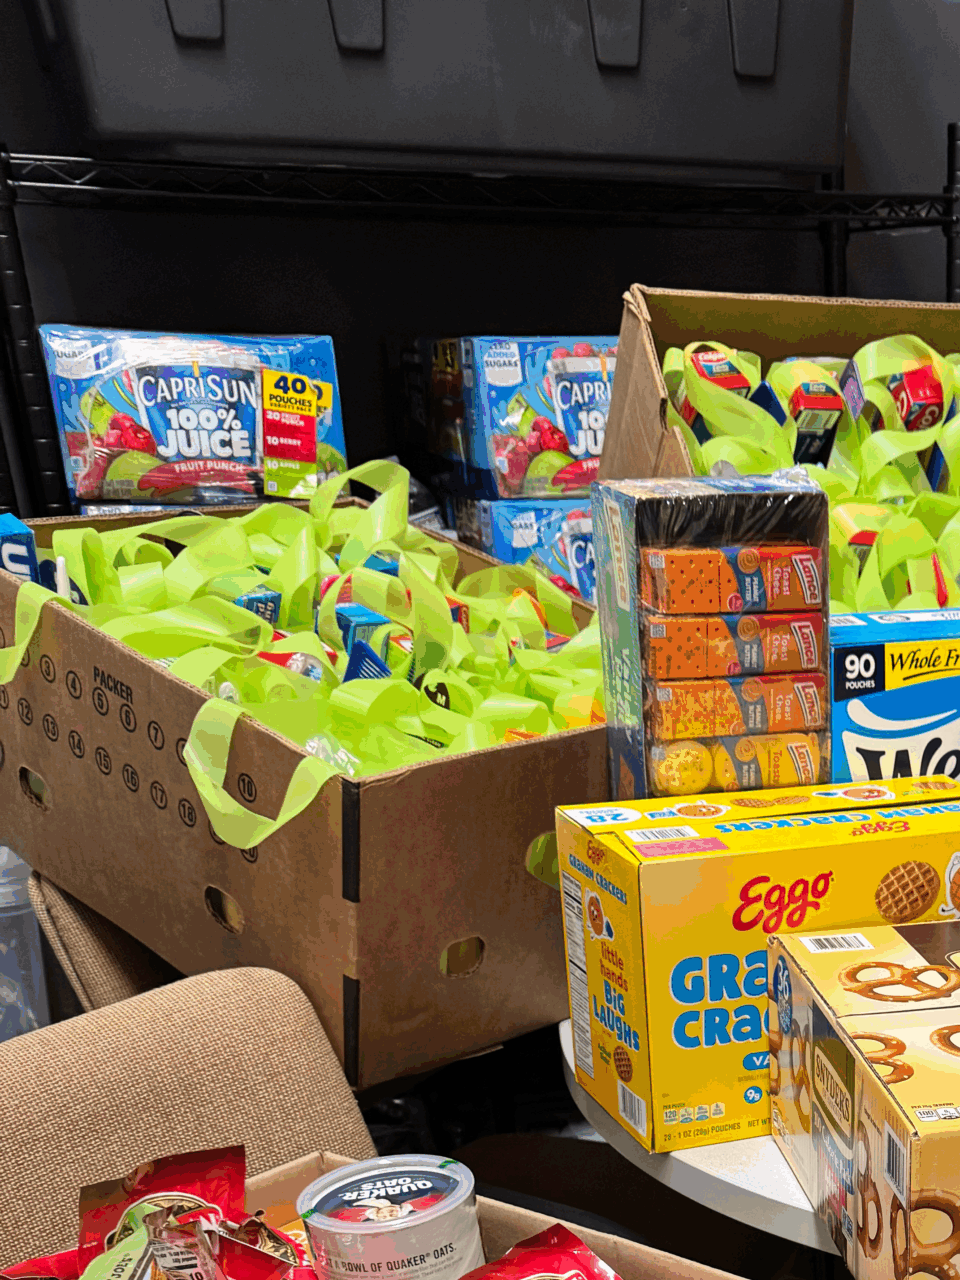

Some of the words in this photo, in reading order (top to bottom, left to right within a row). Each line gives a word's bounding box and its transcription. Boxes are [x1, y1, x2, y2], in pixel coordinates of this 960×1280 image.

[484, 359, 519, 368] SUGARS
[138, 375, 204, 407] CAPRI
[204, 380, 258, 409] SUN
[273, 375, 307, 395] 40
[556, 380, 612, 411] CAPRI
[269, 394, 313, 408] POUCHES
[166, 408, 242, 431] 100%
[266, 411, 280, 421] 20
[156, 430, 252, 458] JUICE
[266, 436, 279, 446] 10
[174, 462, 206, 474] FRUIT
[207, 461, 245, 473] PUNCH
[266, 460, 279, 470] 10
[783, 565, 793, 597] Toast
[801, 557, 819, 604] Lance
[782, 633, 791, 662] Toast
[801, 625, 816, 668] Lance
[845, 653, 875, 679] 90
[889, 649, 942, 672] Whole
[93, 666, 134, 704] PACKER
[845, 679, 875, 690] POUCHES
[785, 693, 794, 721] Toast
[803, 684, 821, 725] Lance
[796, 744, 814, 784] Lance
[851, 820, 911, 837] Eggo
[732, 869, 832, 935] Eggo
[601, 941, 624, 971] little
[600, 958, 628, 992] hands
[777, 958, 790, 1001] 36
[746, 1088, 761, 1101] 9g
[815, 1053, 850, 1124] SNYDER'S
[664, 1109, 677, 1119] 120
[683, 1130, 693, 1139] OZ
[711, 1122, 742, 1134] POUCHES
[748, 1118, 760, 1128] NET
[338, 1179, 434, 1201] QUAKER
[360, 1177, 412, 1190] OATS
[342, 1261, 369, 1273] BOWL
[371, 1261, 383, 1273] OF
